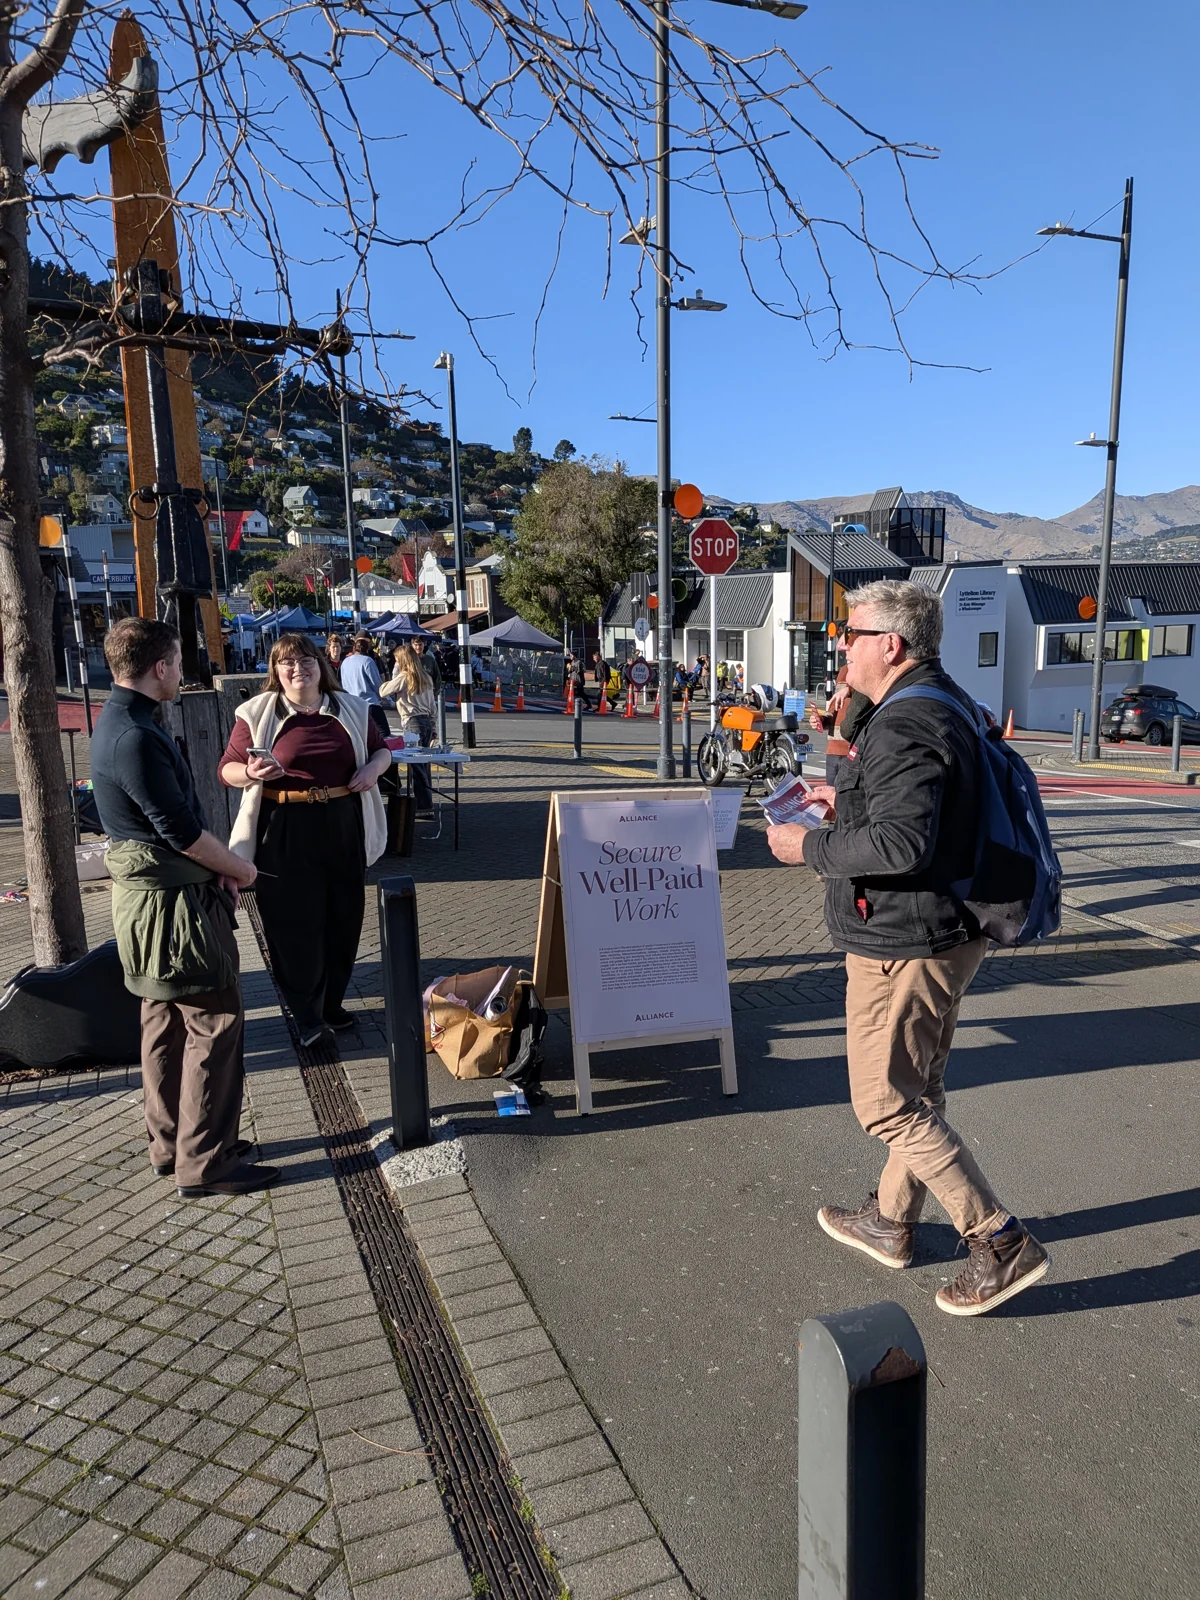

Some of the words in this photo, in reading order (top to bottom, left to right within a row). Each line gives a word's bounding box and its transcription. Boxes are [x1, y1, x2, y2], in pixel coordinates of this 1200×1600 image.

[694, 537, 735, 557] STOP
[92, 575, 131, 583] CANERBURY
[598, 840, 682, 865] Secure
[578, 865, 704, 895] Well-Paid
[612, 894, 680, 922] Work
[635, 1012, 674, 1022] ALLIANCE
